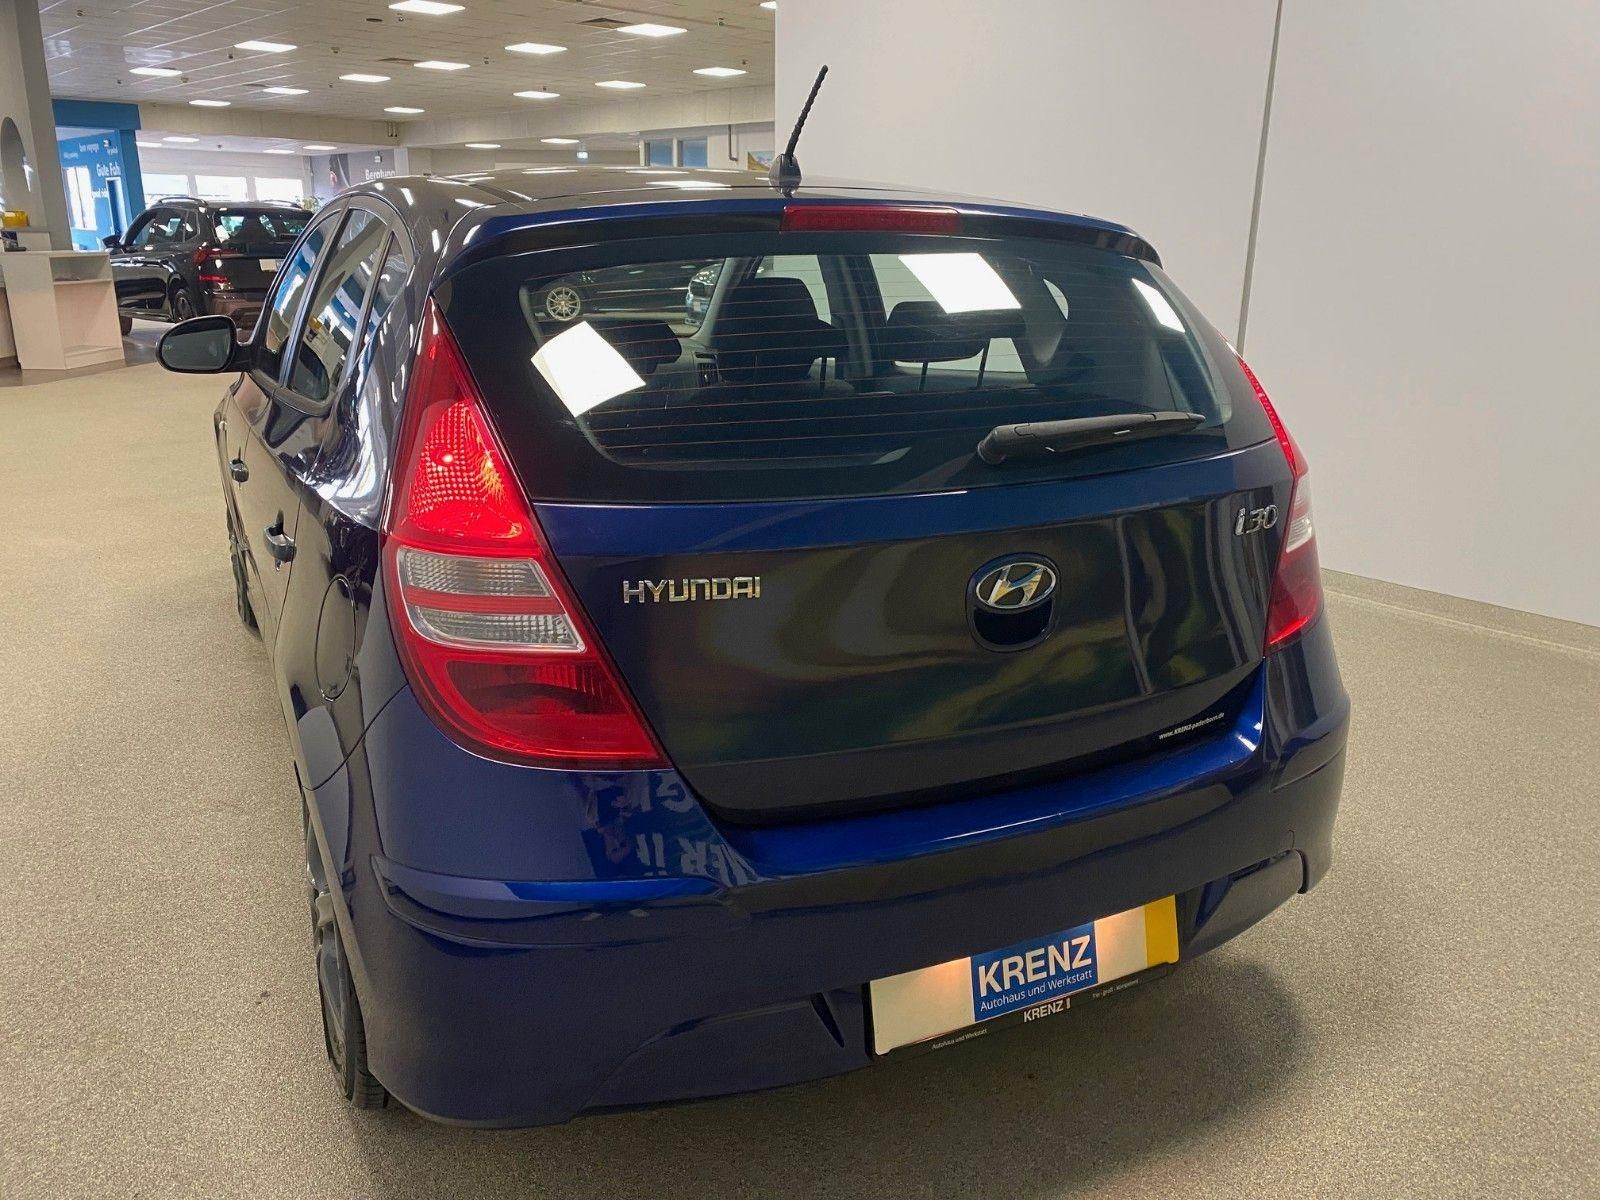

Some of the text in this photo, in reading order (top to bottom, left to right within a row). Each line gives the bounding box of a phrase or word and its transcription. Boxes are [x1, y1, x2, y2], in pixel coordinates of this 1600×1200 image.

[1235, 504, 1279, 536] i30
[622, 576, 761, 604] HYUNDAI
[978, 934, 1092, 997] KRENZ
[980, 989, 1026, 1012] Autohaus
[1027, 982, 1046, 997] und
[1047, 969, 1093, 993] Werkstatt
[1023, 999, 1064, 1023] KRENZ
